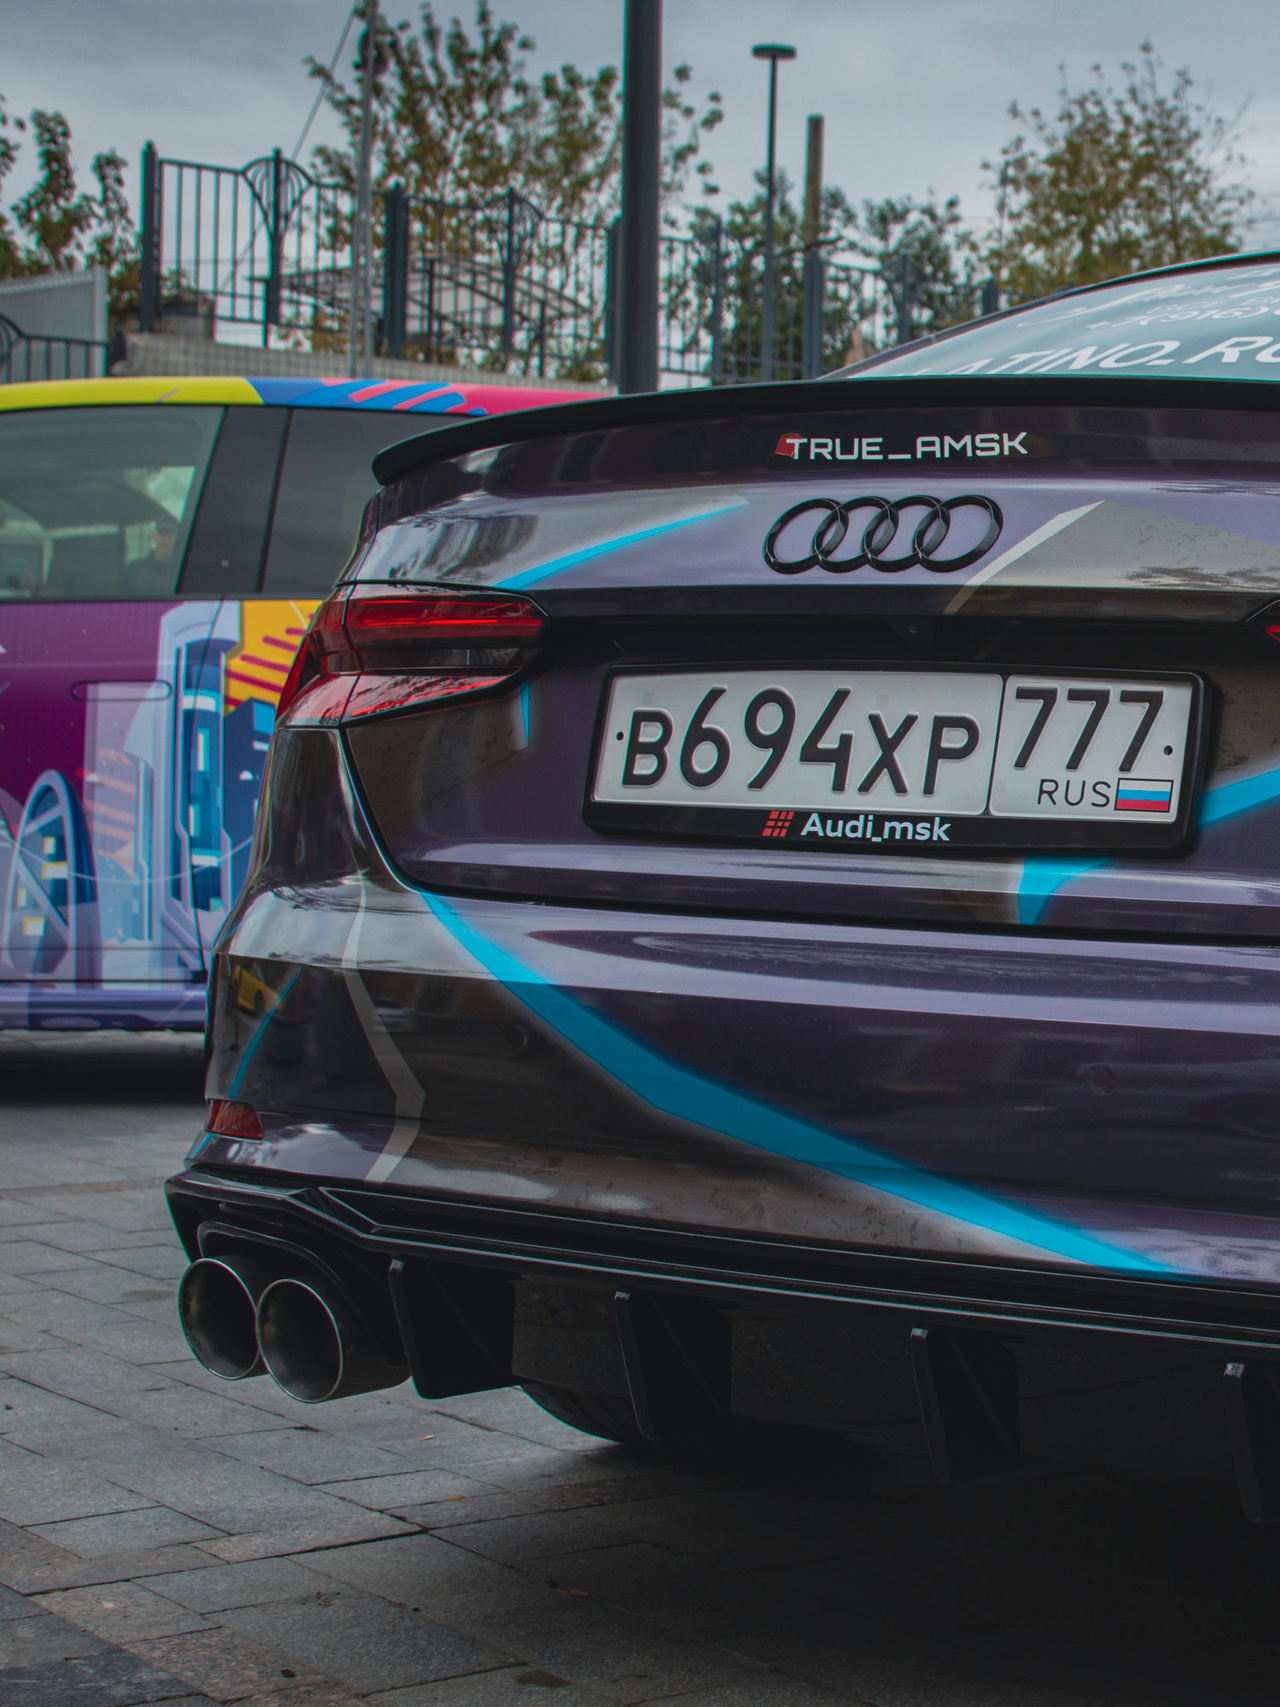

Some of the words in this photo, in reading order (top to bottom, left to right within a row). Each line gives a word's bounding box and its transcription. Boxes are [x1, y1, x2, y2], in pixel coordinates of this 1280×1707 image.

[785, 432, 1029, 460] TRUE_AMSK
[1013, 686, 1165, 772] 777
[1036, 777, 1112, 808] RUS
[800, 812, 952, 843] Audi_msk
